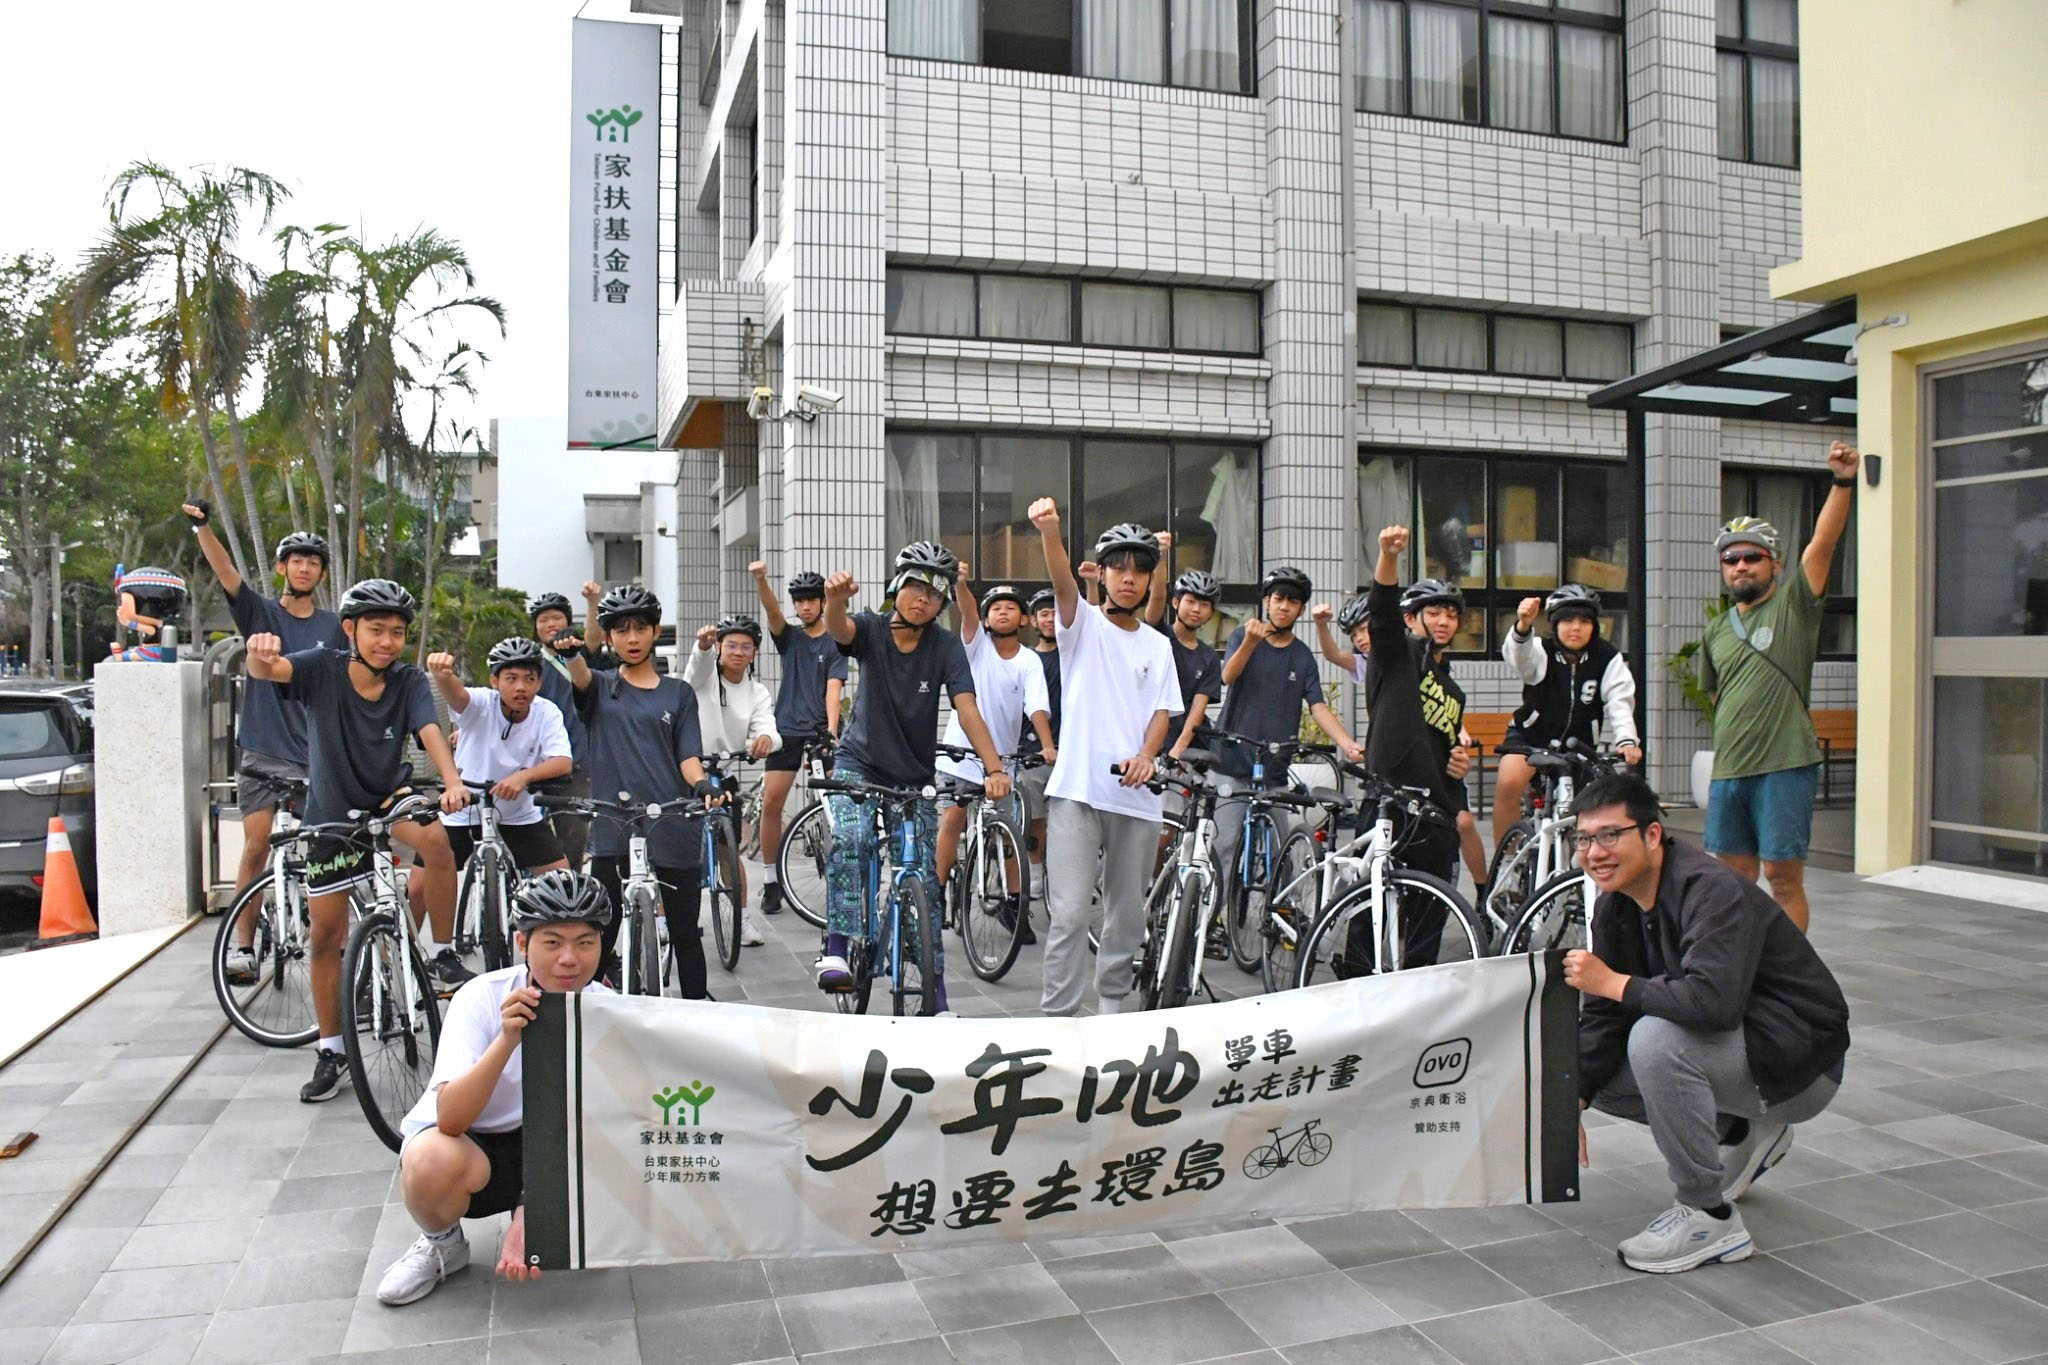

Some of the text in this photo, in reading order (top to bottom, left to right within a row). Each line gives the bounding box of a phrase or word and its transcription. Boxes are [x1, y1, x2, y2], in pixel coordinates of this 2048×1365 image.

[604, 153, 631, 304] 家扶基金會
[1224, 1028, 1296, 1070] 單車
[1212, 1054, 1363, 1108] 出走計畫
[1409, 1091, 1467, 1110] 京典衛浴
[1414, 1121, 1461, 1134] 贊助支持
[640, 1131, 724, 1145] 家扶基金會
[644, 1155, 721, 1168] 台東家扶中心
[643, 1170, 721, 1184] 少年展力方案
[869, 1138, 1225, 1238] 想要去環島
